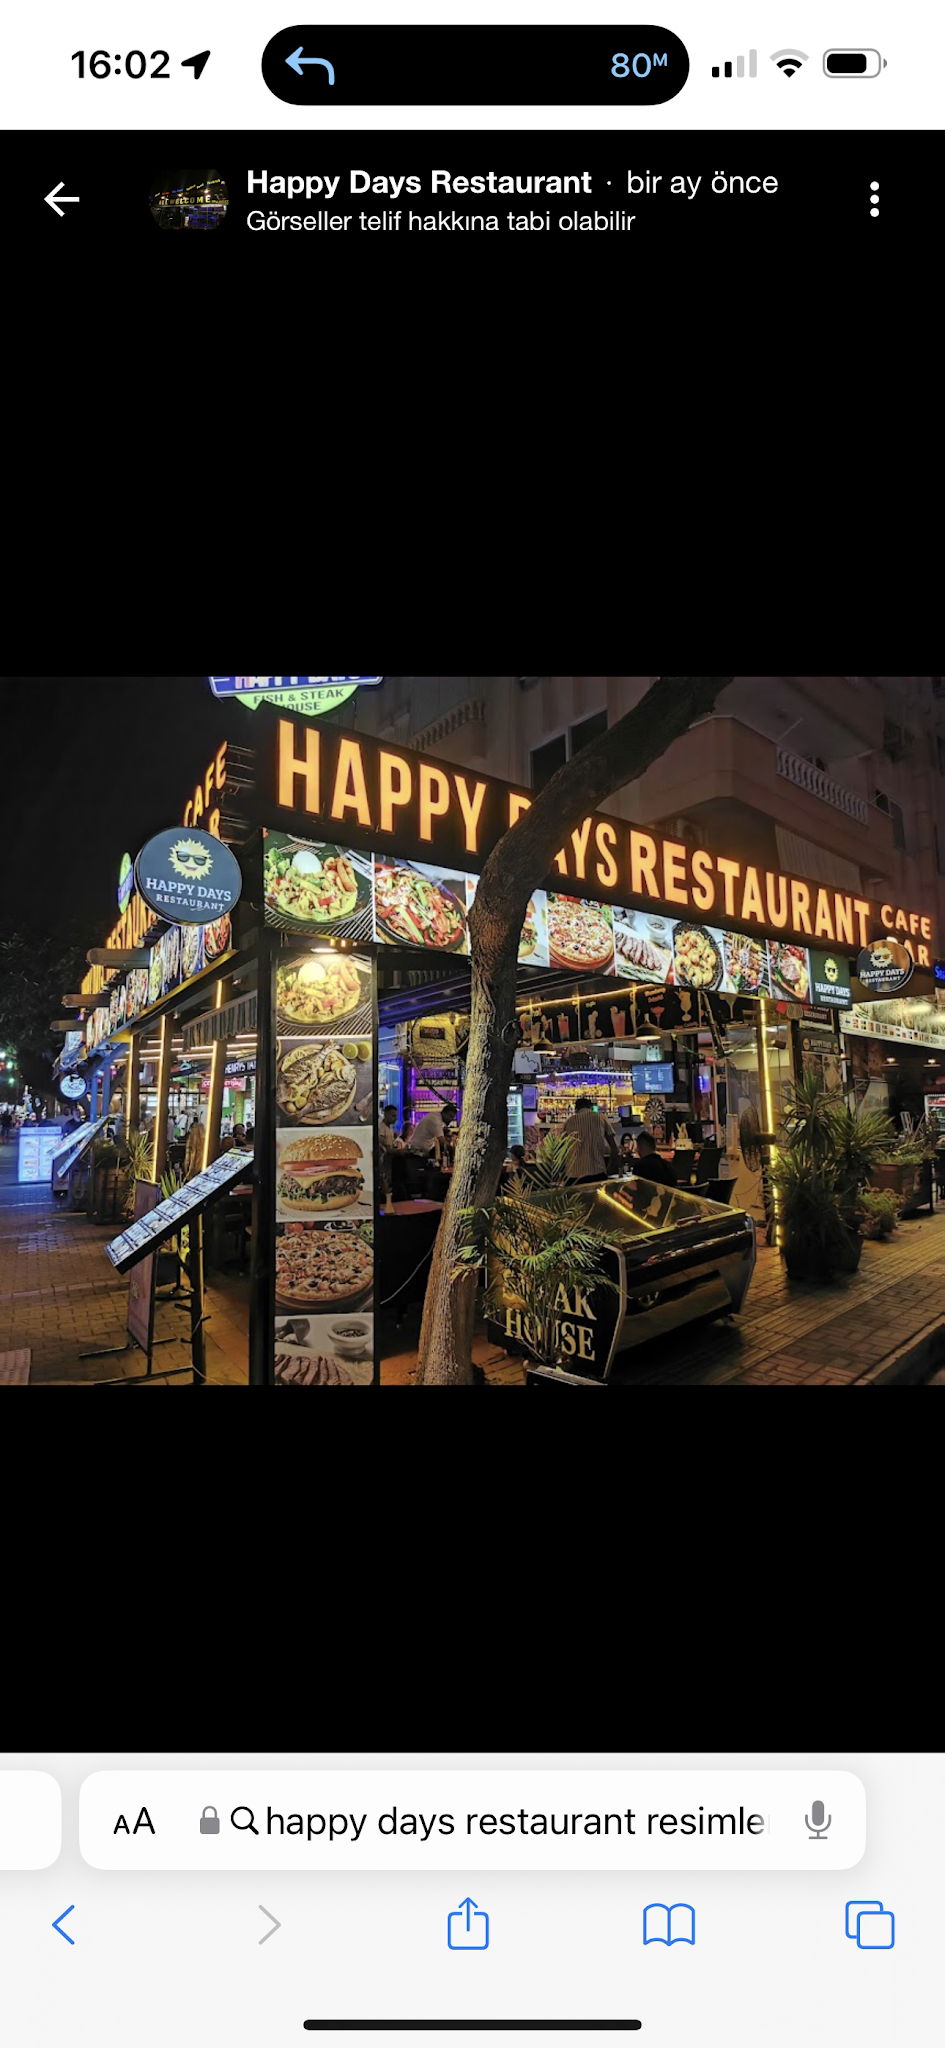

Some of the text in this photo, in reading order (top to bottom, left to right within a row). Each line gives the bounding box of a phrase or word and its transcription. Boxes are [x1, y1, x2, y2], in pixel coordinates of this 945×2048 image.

[254, 694, 283, 704] FISH
[300, 688, 344, 701] STEAK
[281, 702, 321, 712] OUSE
[184, 741, 228, 829] CAFE
[278, 719, 486, 853] HAPPY
[630, 829, 870, 948] RESTAURANT
[145, 877, 232, 902] HAPPY DAYS
[156, 893, 225, 912] RESTAURANT
[880, 904, 932, 939] CAFE
[860, 968, 905, 979] HAPPY DAYS
[815, 983, 851, 997] HAPPY DAYS
